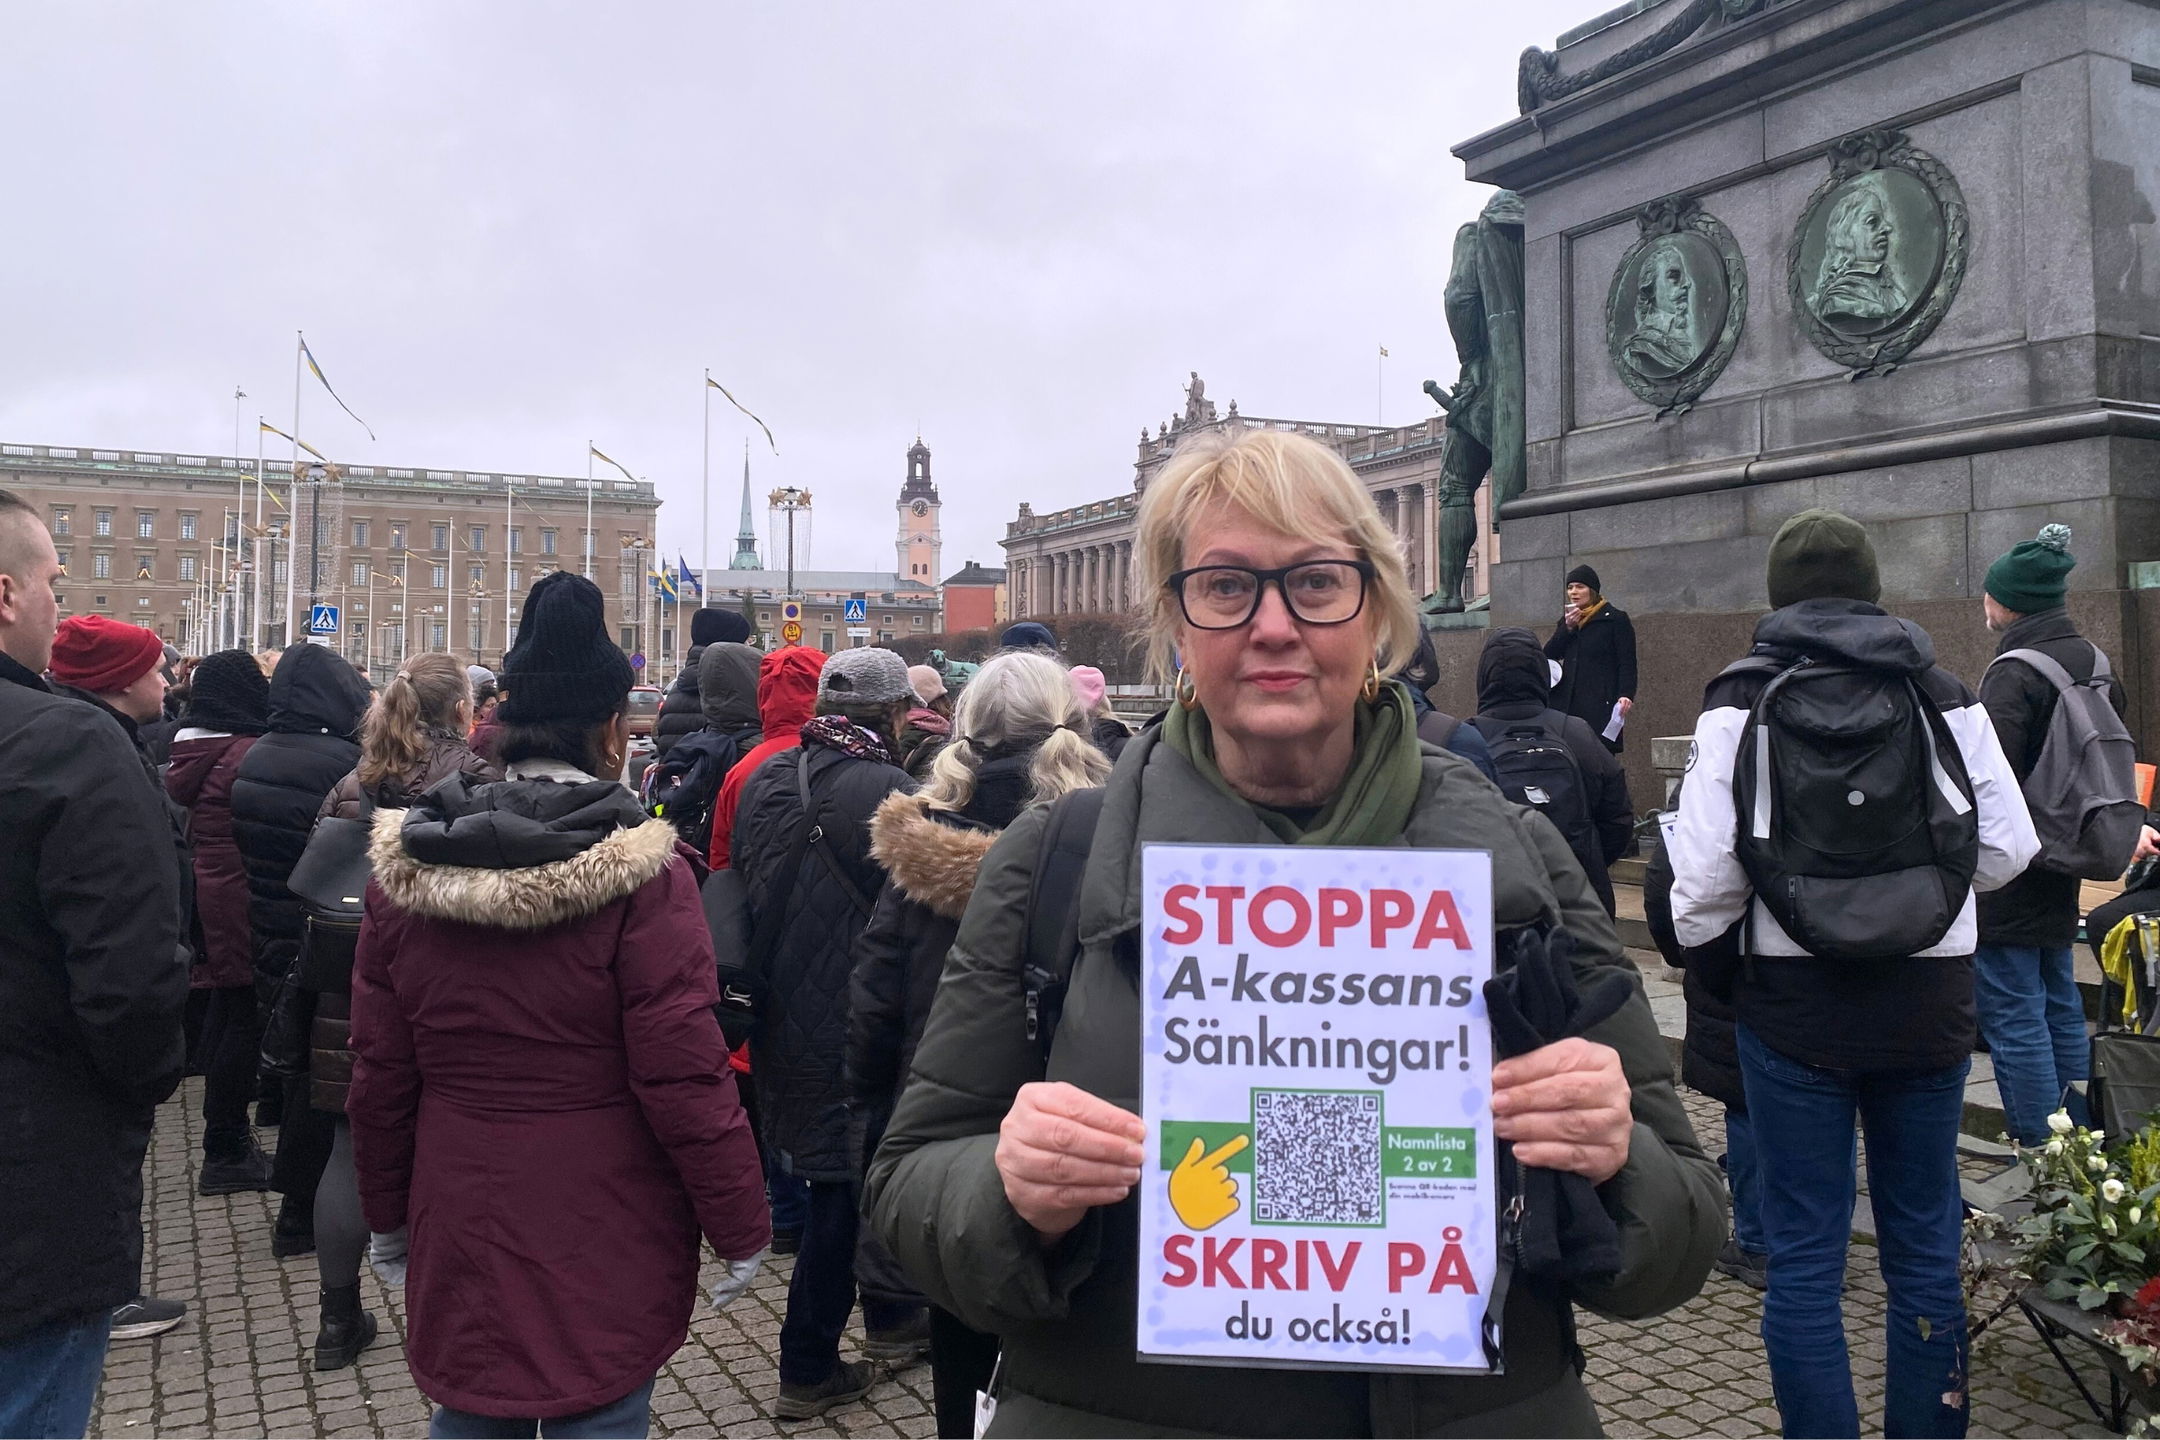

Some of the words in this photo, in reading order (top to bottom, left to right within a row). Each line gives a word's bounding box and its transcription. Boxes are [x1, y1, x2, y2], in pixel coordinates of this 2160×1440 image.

[1161, 883, 1473, 951] STOPPA
[1162, 953, 1473, 1008] A-kassans
[1163, 1014, 1470, 1085] Sänkningar!
[1388, 1132, 1466, 1150] Namnlista
[1403, 1155, 1414, 1172] 2
[1418, 1161, 1437, 1172] av
[1442, 1156, 1453, 1173] 2
[1161, 1234, 1363, 1292] SKRIV
[1387, 1226, 1480, 1296] PÅ
[1225, 1299, 1273, 1341] du
[1287, 1302, 1411, 1346] också!
